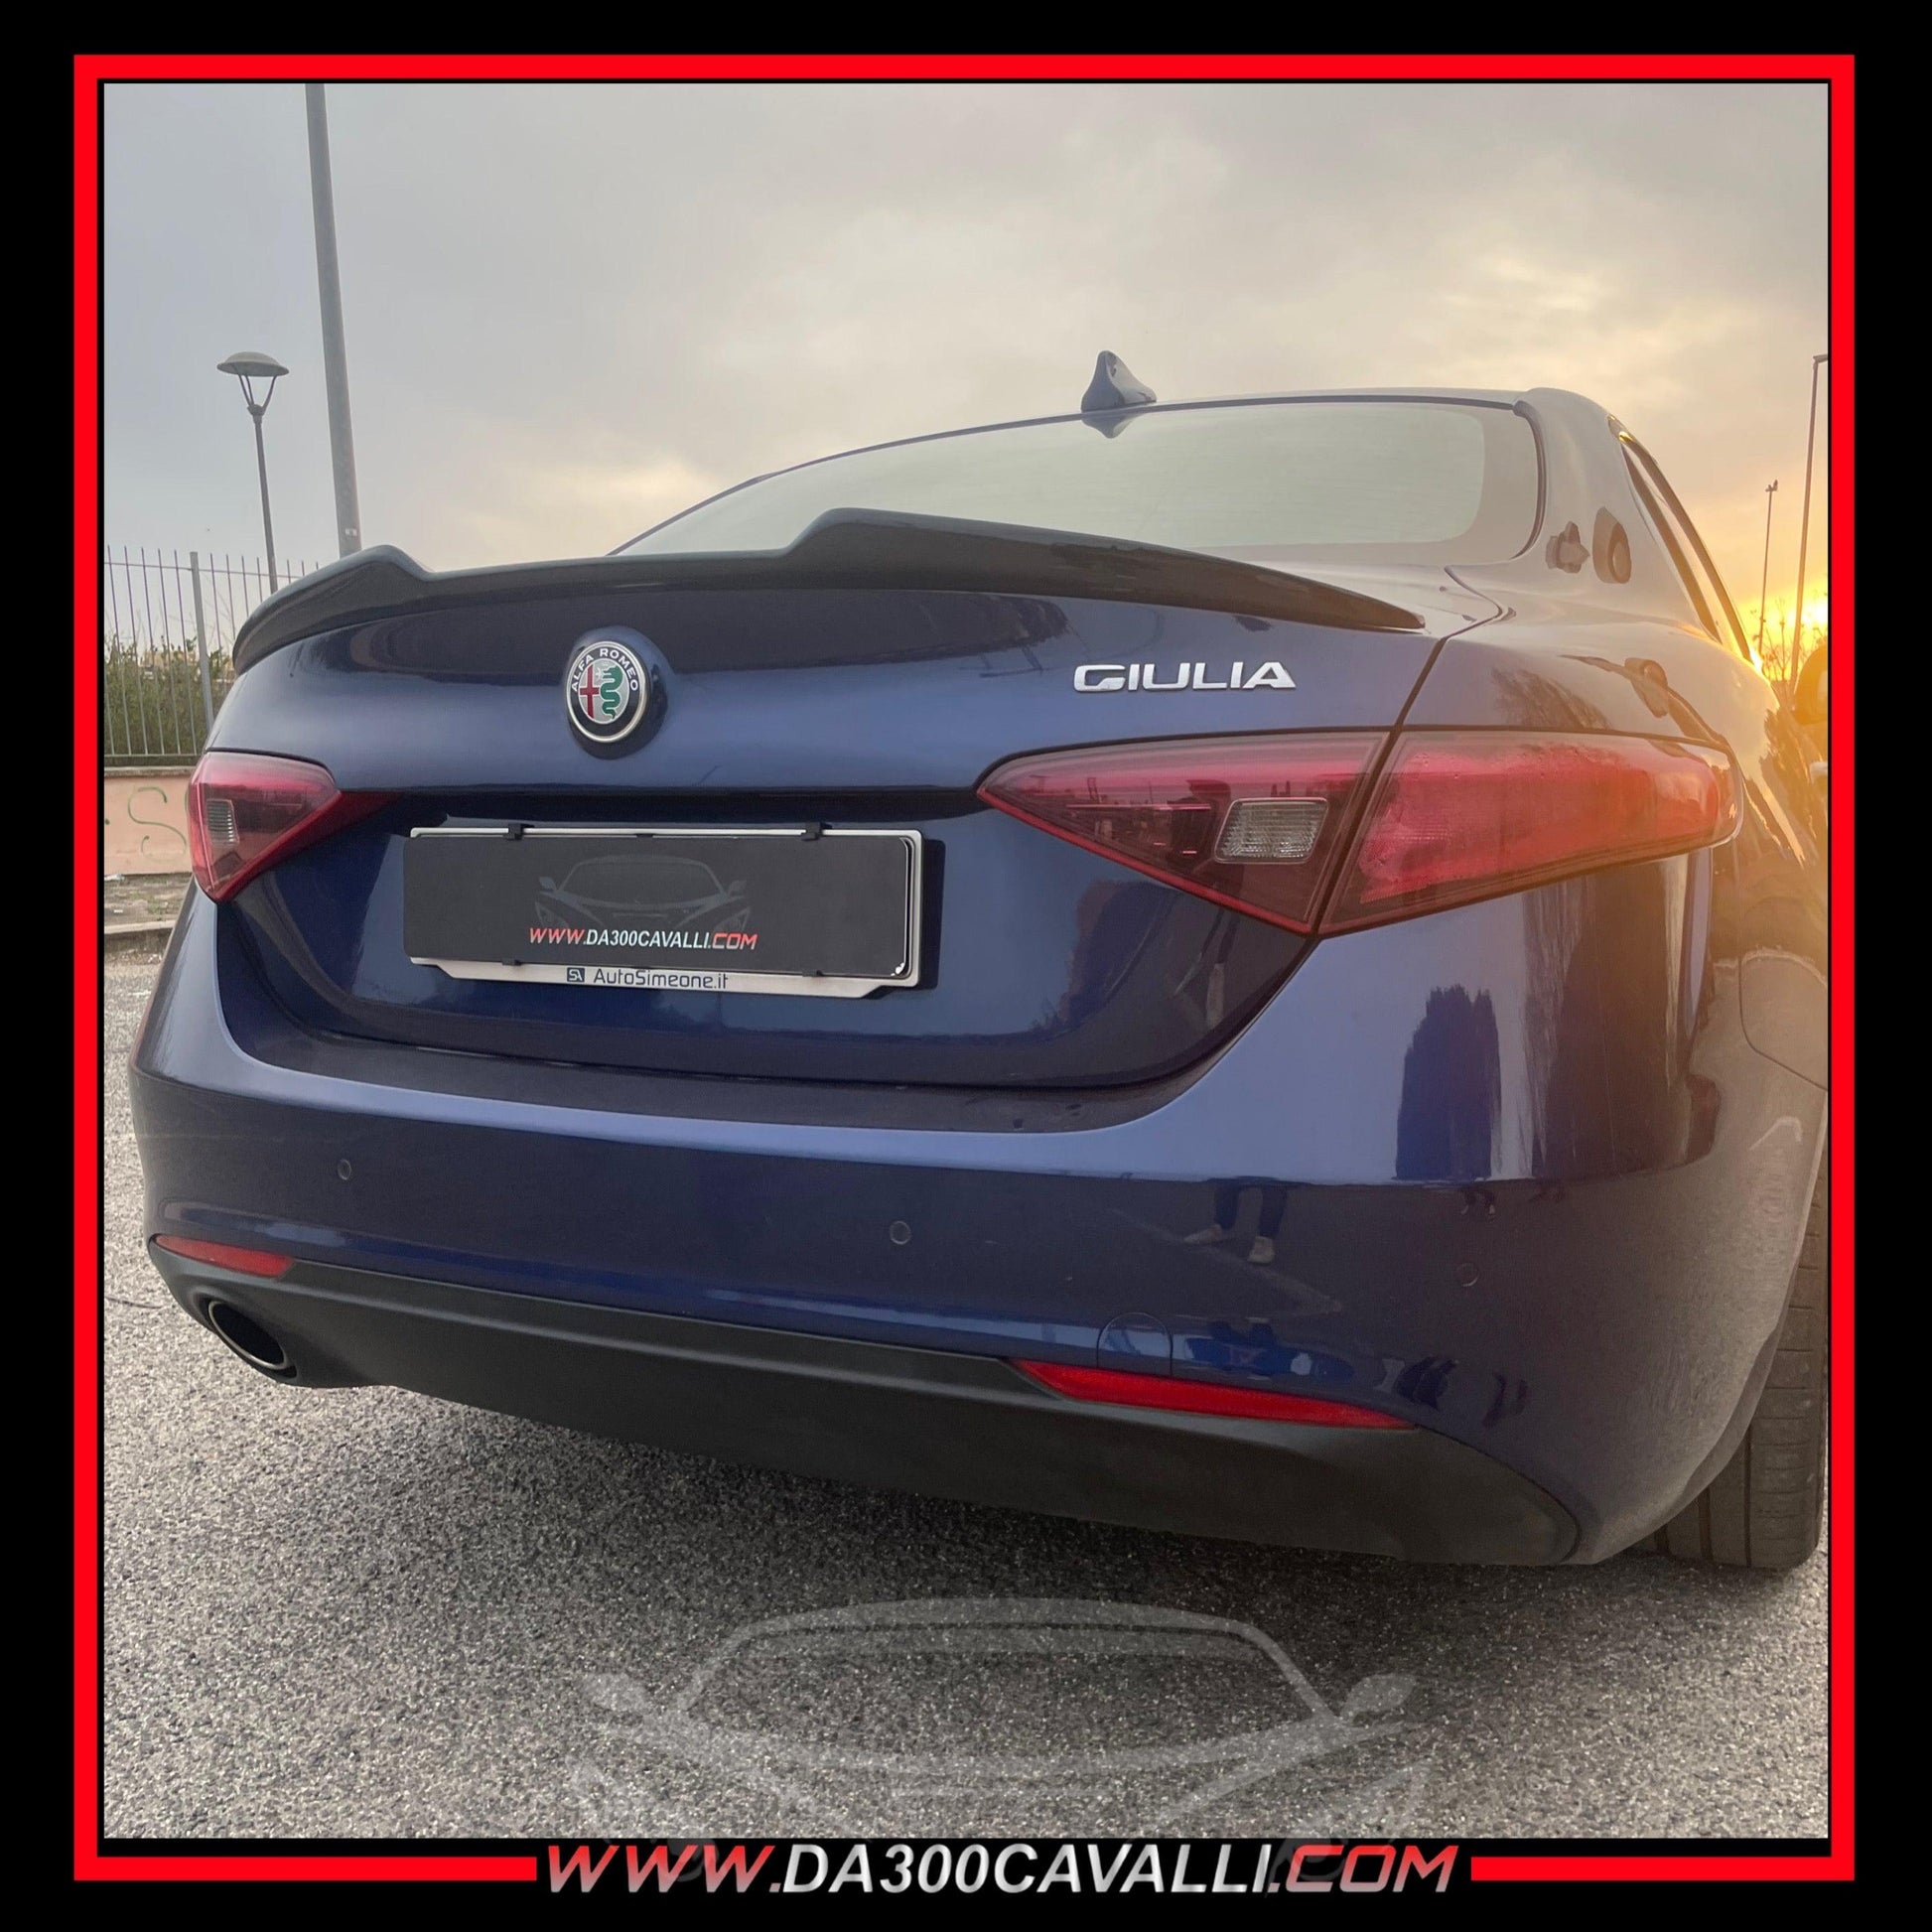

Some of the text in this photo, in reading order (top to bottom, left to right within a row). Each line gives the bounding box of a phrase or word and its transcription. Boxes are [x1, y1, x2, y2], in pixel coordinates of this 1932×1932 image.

[572, 648, 638, 691] ALFA ROMEO
[1073, 661, 1297, 692] GIULIA
[594, 968, 728, 989] AutoSimeone.it
